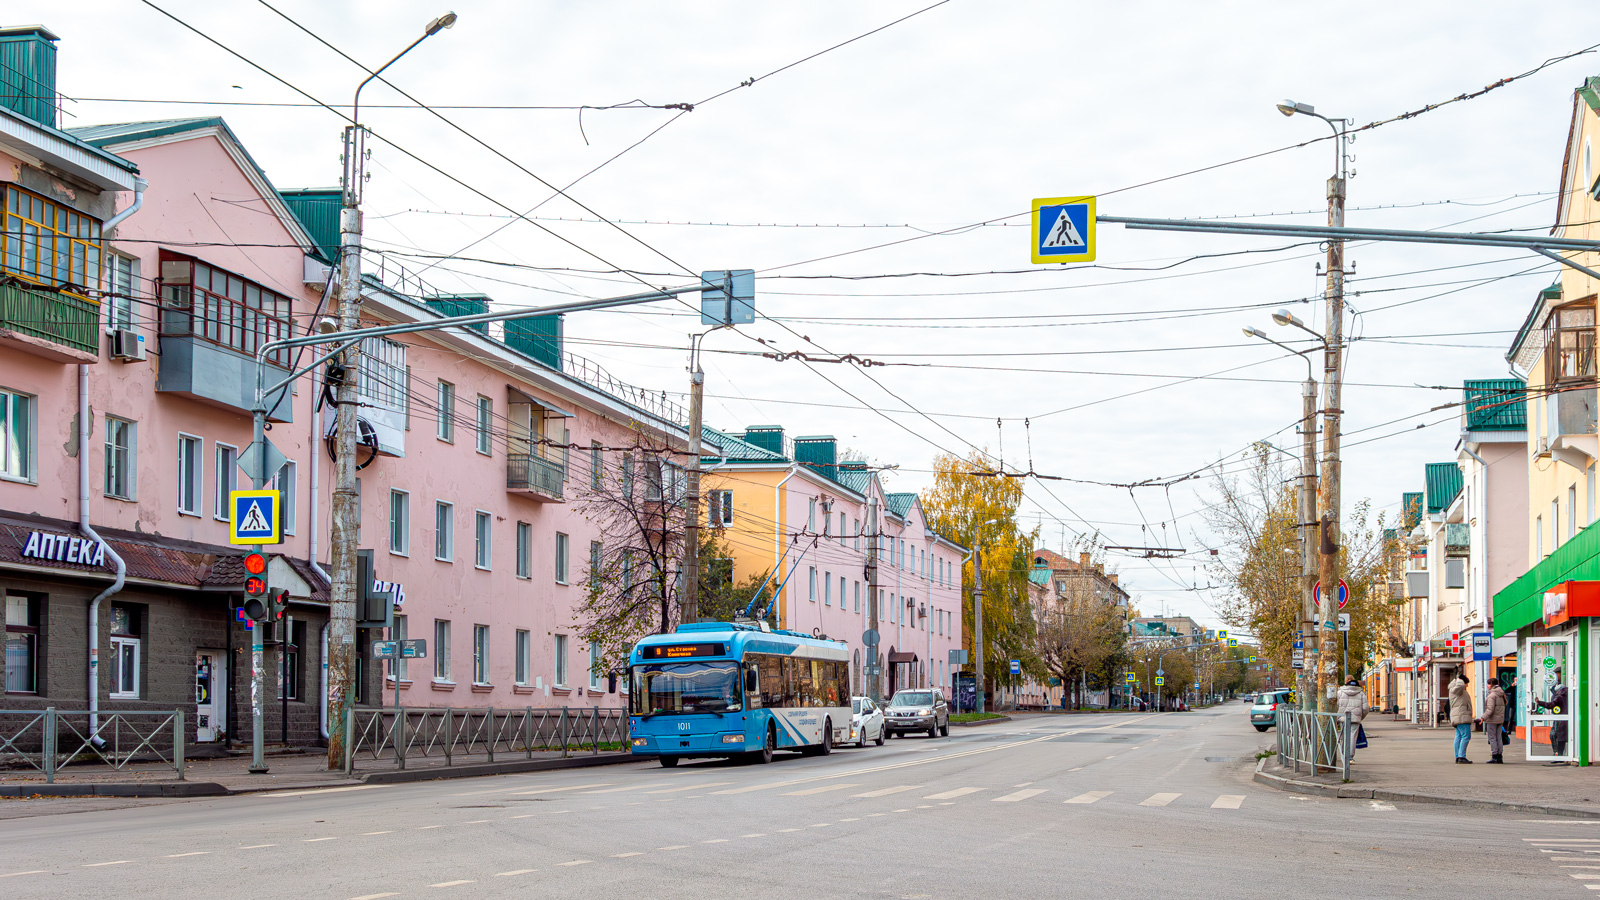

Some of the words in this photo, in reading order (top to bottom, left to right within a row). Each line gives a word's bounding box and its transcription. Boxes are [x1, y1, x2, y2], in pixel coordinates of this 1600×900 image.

[22, 531, 104, 567] АПТЕКА
[248, 579, 264, 593] 34
[656, 647, 661, 655] 9
[677, 722, 691, 730] 1011
